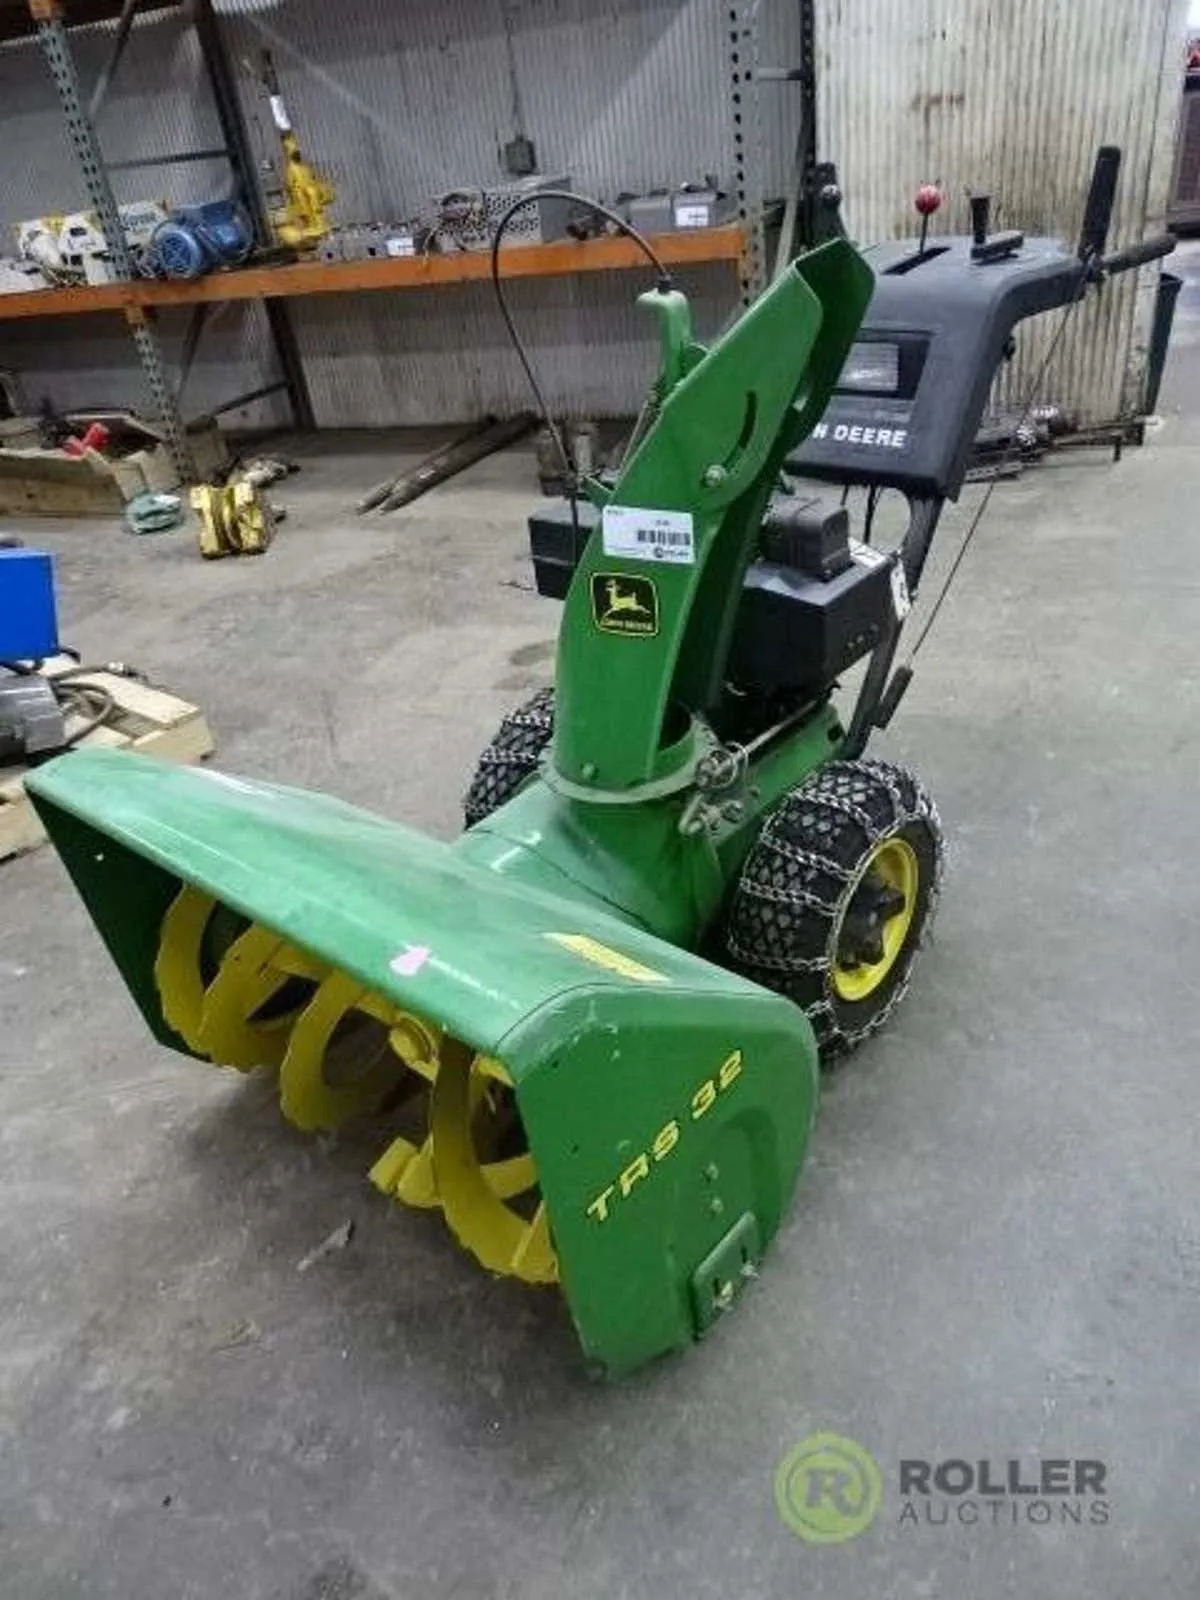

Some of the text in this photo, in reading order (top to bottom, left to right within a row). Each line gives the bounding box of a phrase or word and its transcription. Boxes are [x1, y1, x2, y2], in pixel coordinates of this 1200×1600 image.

[833, 424, 908, 448] DEERE
[586, 1049, 743, 1222] TRS 32
